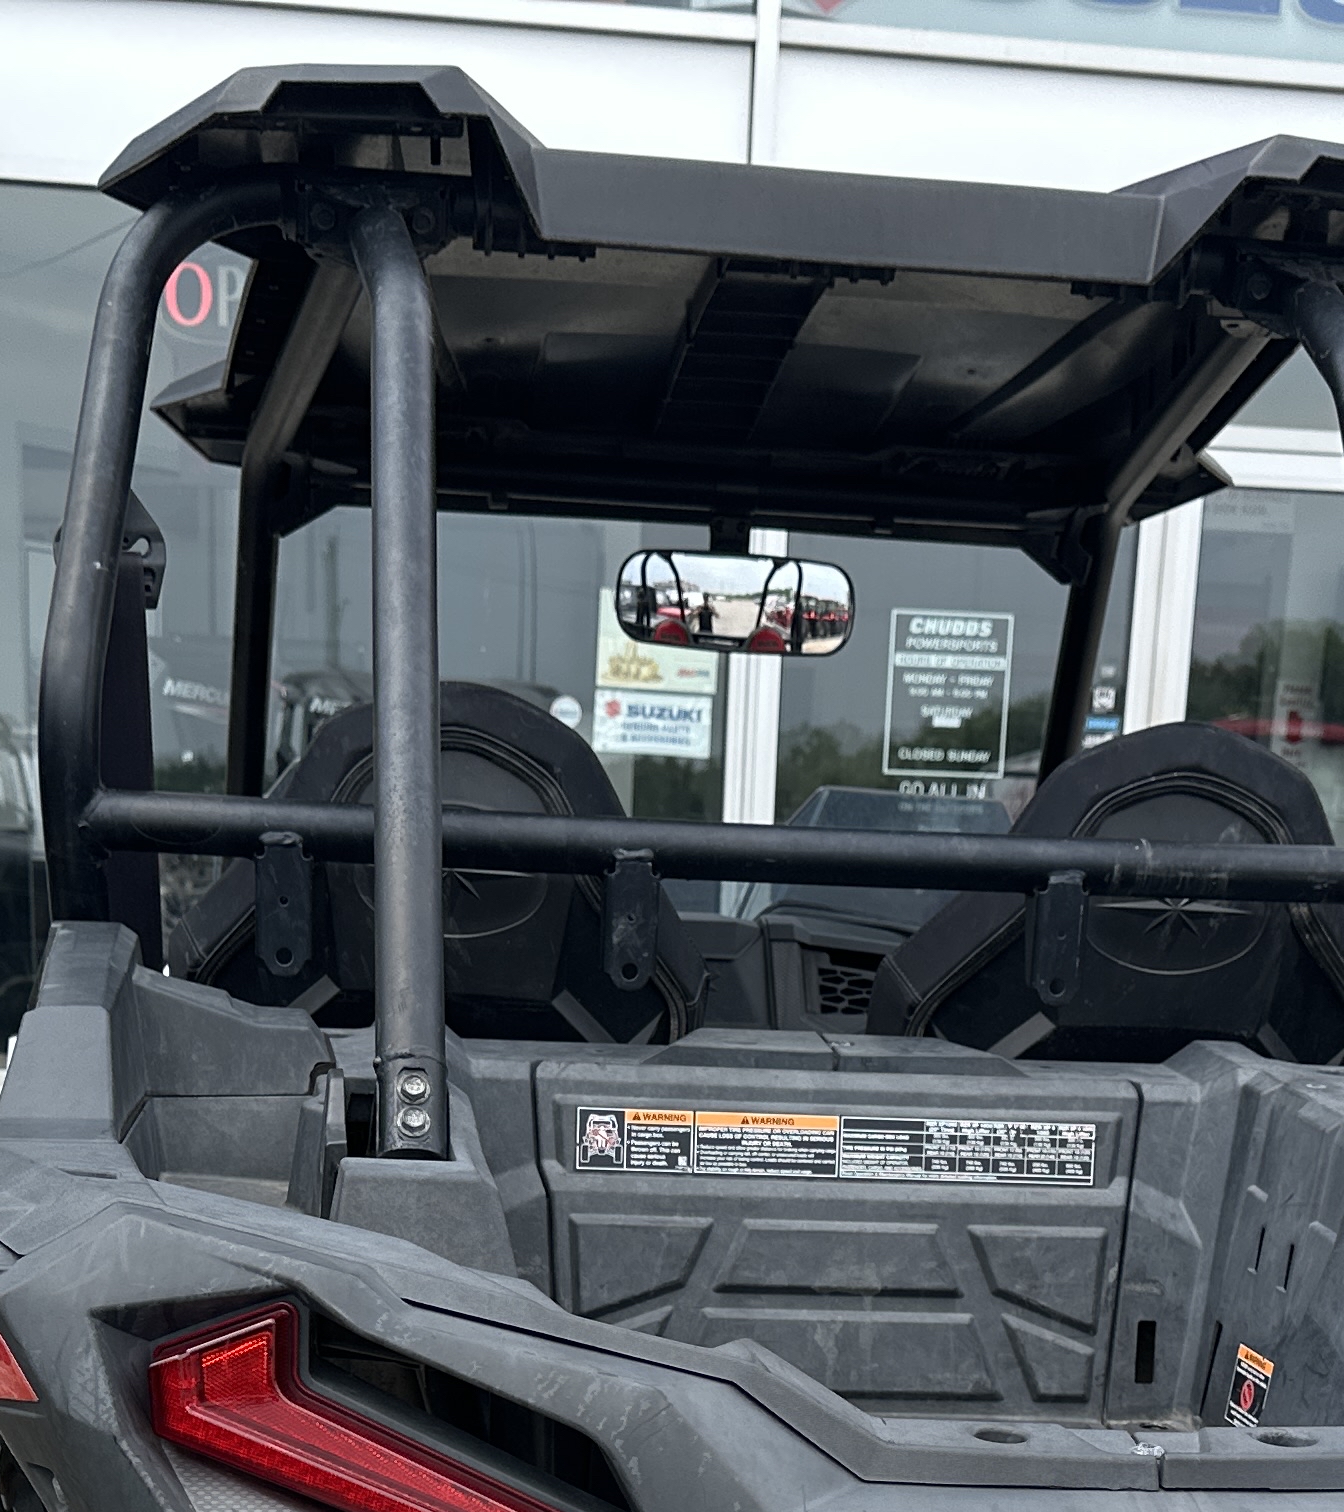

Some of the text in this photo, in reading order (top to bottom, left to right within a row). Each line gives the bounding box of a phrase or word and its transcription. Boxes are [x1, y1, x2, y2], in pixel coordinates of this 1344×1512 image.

[909, 616, 994, 637] CHUDDS
[905, 637, 999, 653] POWERSPORTS
[627, 704, 702, 722] SUZUKI
[642, 1112, 687, 1122] WARNING
[750, 1116, 795, 1126] WARNING
